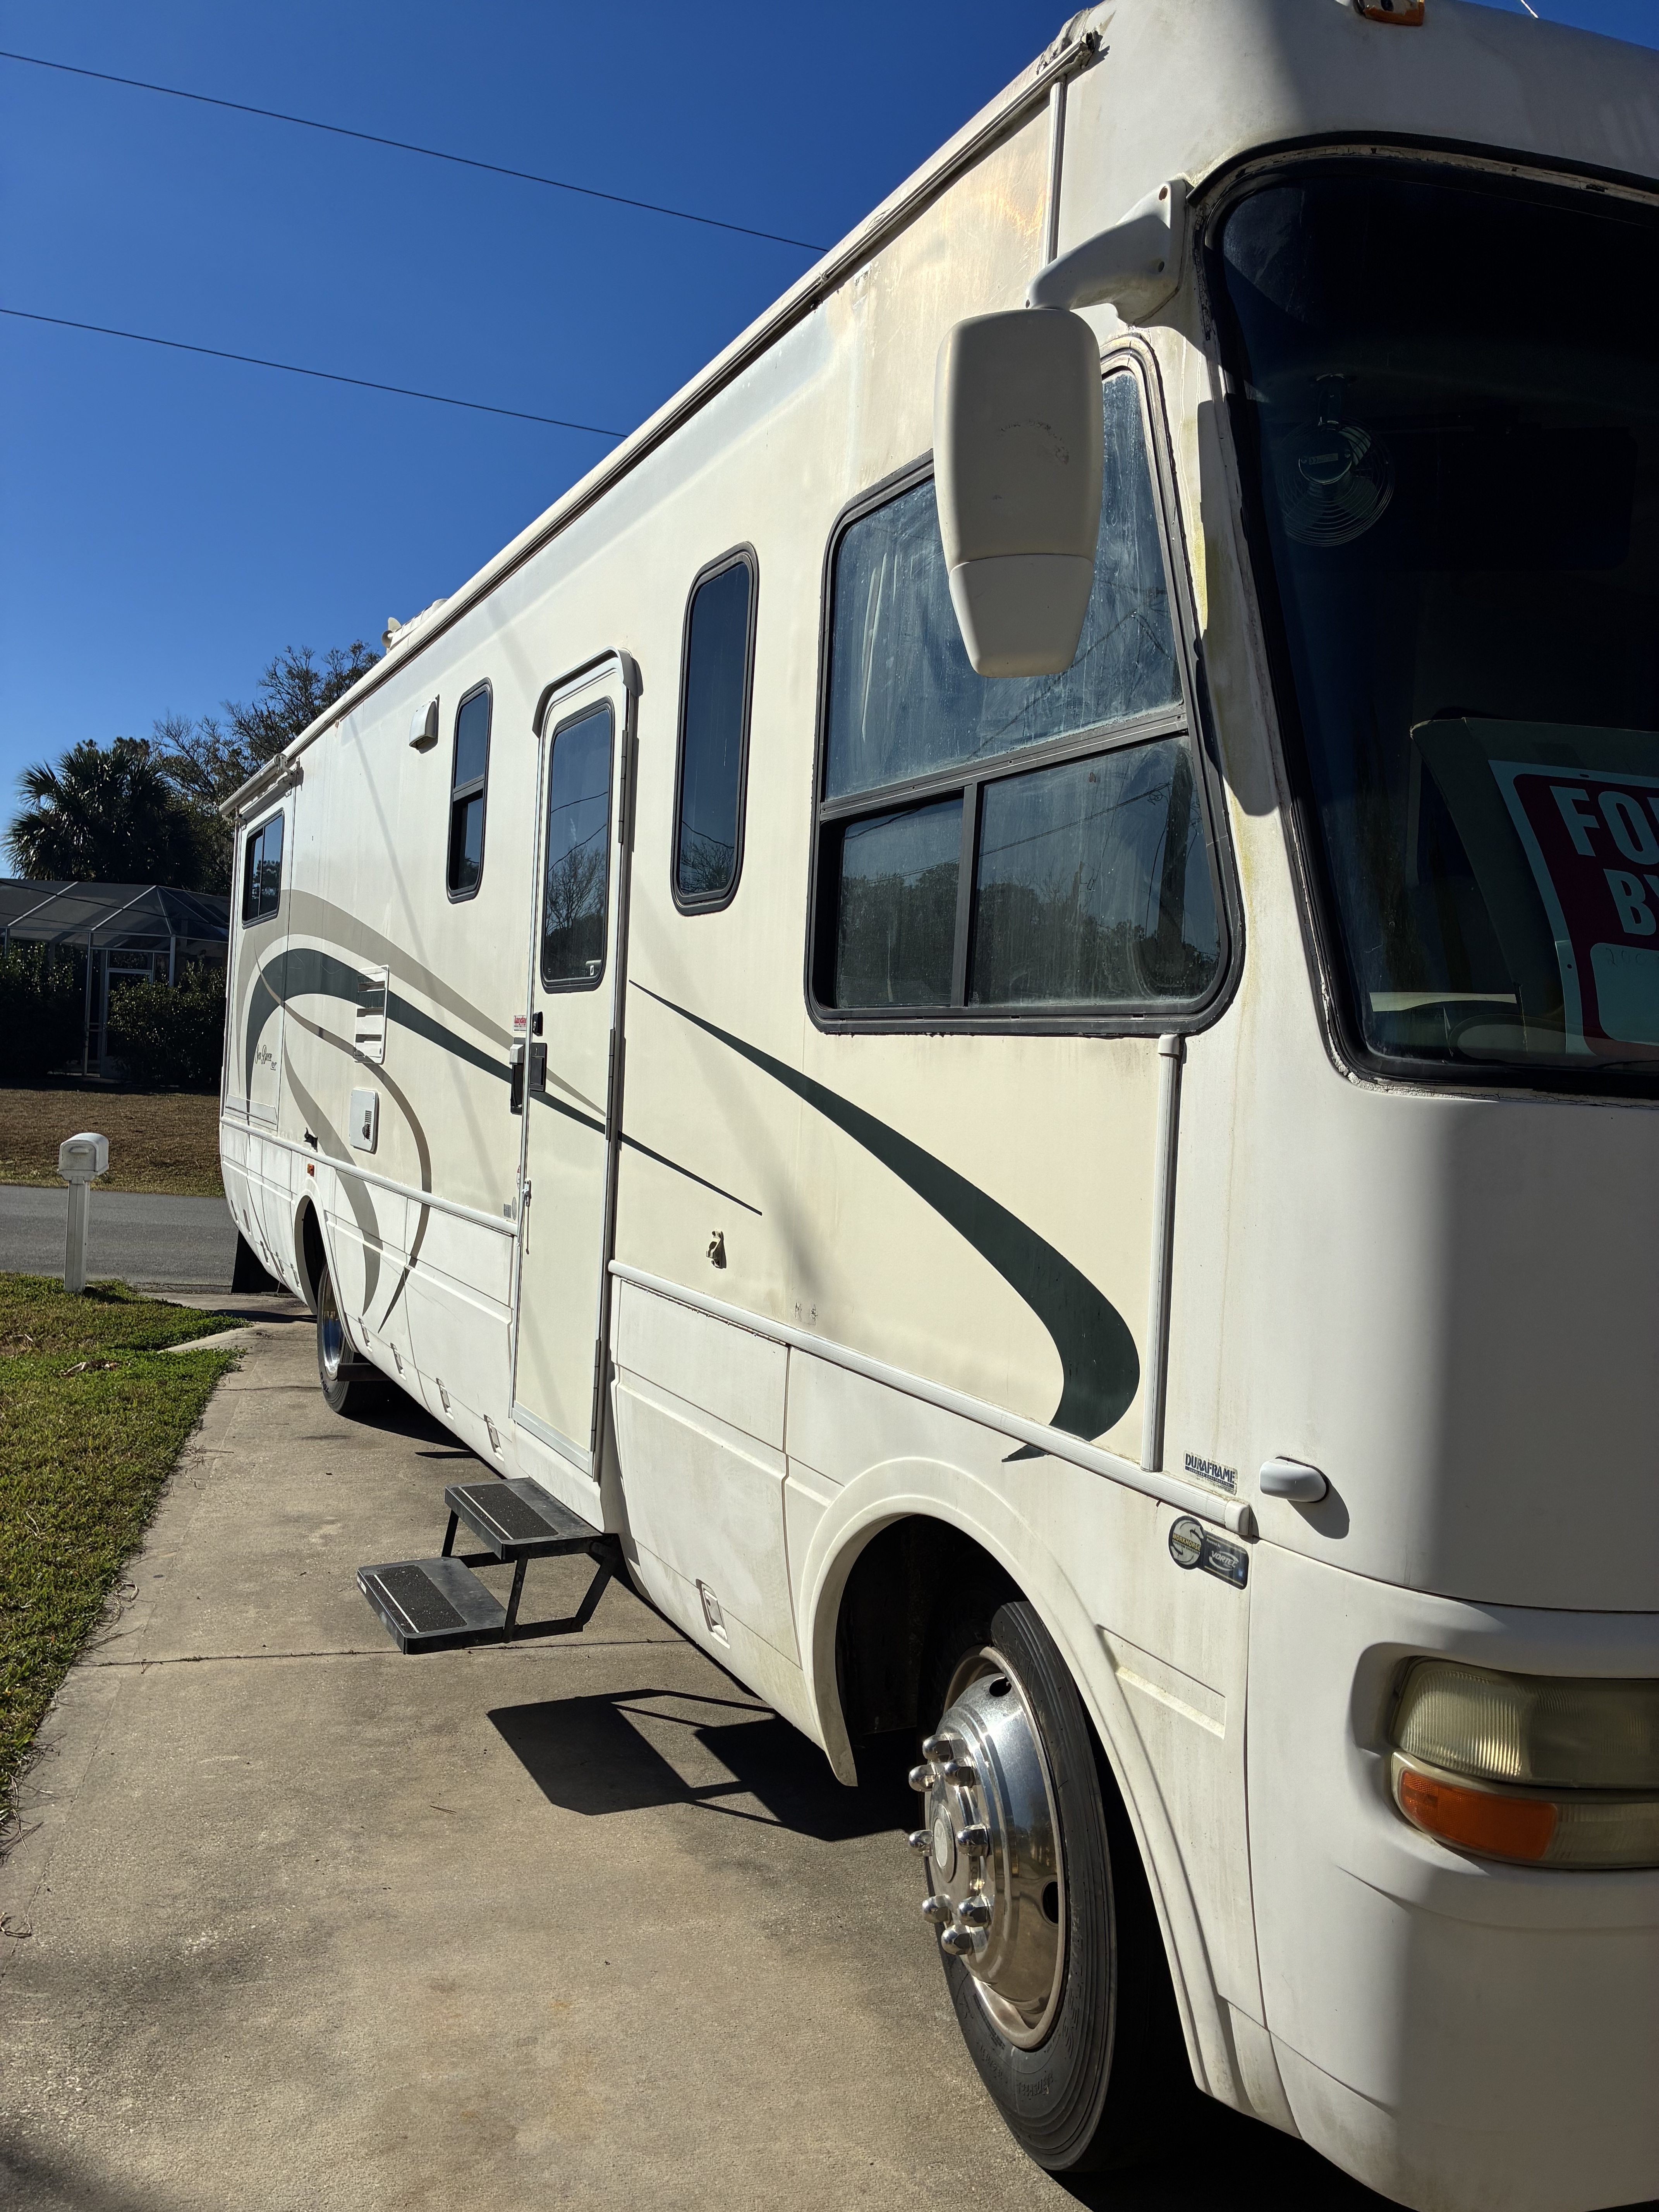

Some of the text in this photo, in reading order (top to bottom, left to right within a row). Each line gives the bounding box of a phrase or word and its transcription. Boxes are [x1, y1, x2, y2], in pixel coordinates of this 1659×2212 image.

[1603, 868, 1659, 935] B
[1185, 1453, 1235, 1484] DURAFRAME
[1172, 1532, 1201, 1551] WORKHORSE
[1211, 1551, 1238, 1568] VORTEC
